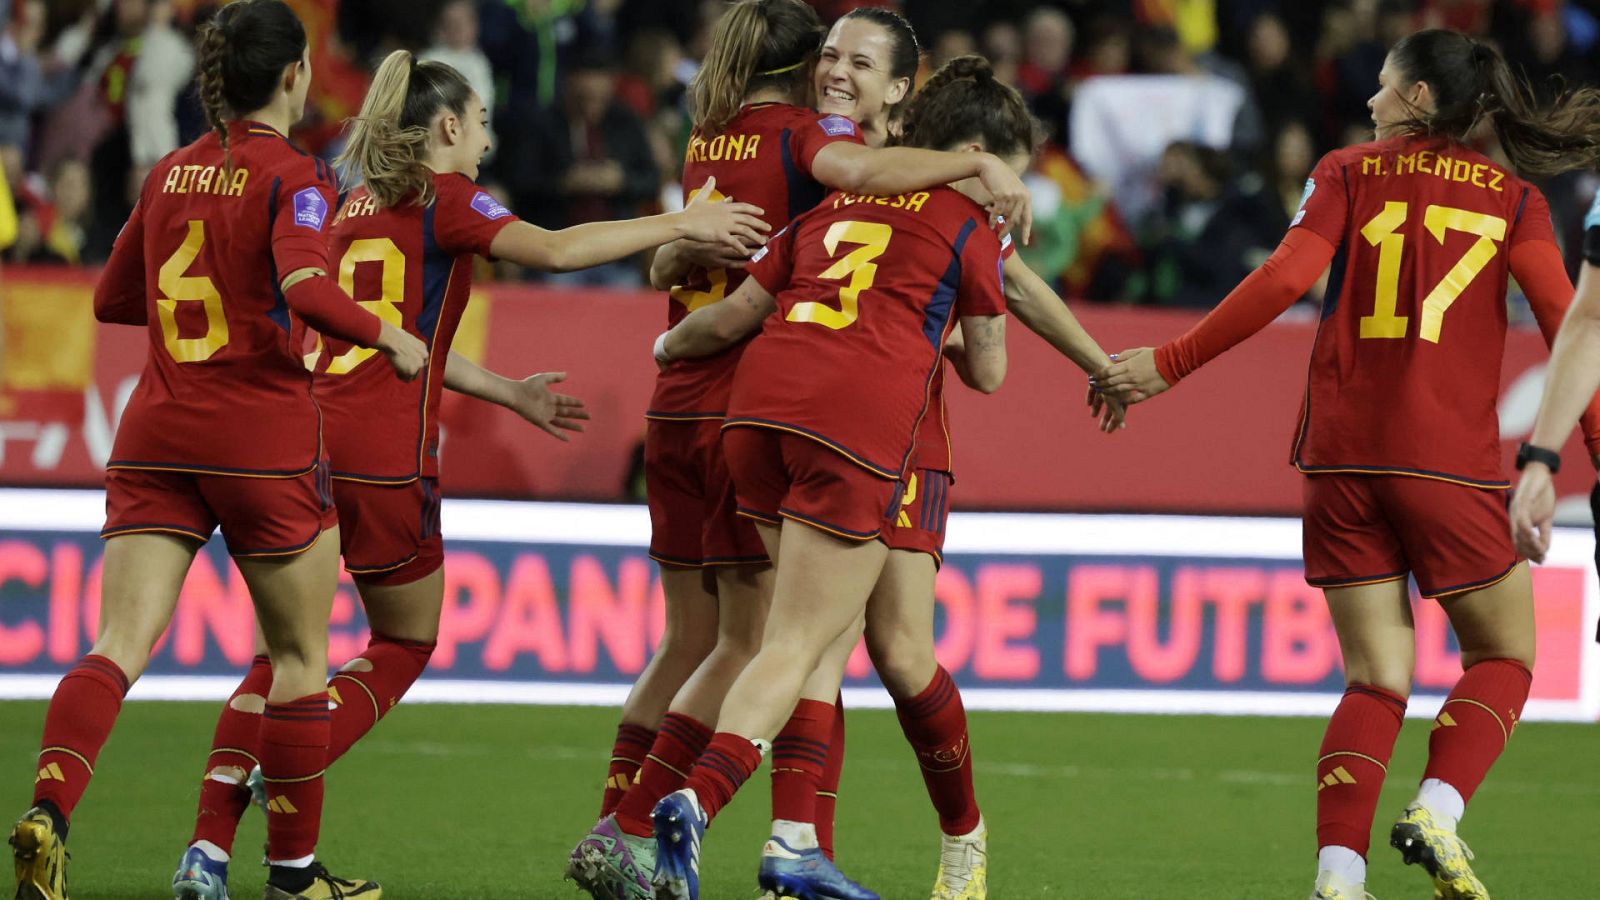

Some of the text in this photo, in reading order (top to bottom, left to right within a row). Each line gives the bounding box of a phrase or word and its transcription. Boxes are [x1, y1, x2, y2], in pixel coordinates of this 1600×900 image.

[163, 165, 249, 197] AITANA
[1362, 151, 1505, 192] M. MENDEZ
[156, 219, 230, 364] 6
[785, 220, 893, 330] 3
[1360, 201, 1508, 344] 17
[1064, 564, 1466, 688] FUTBL
